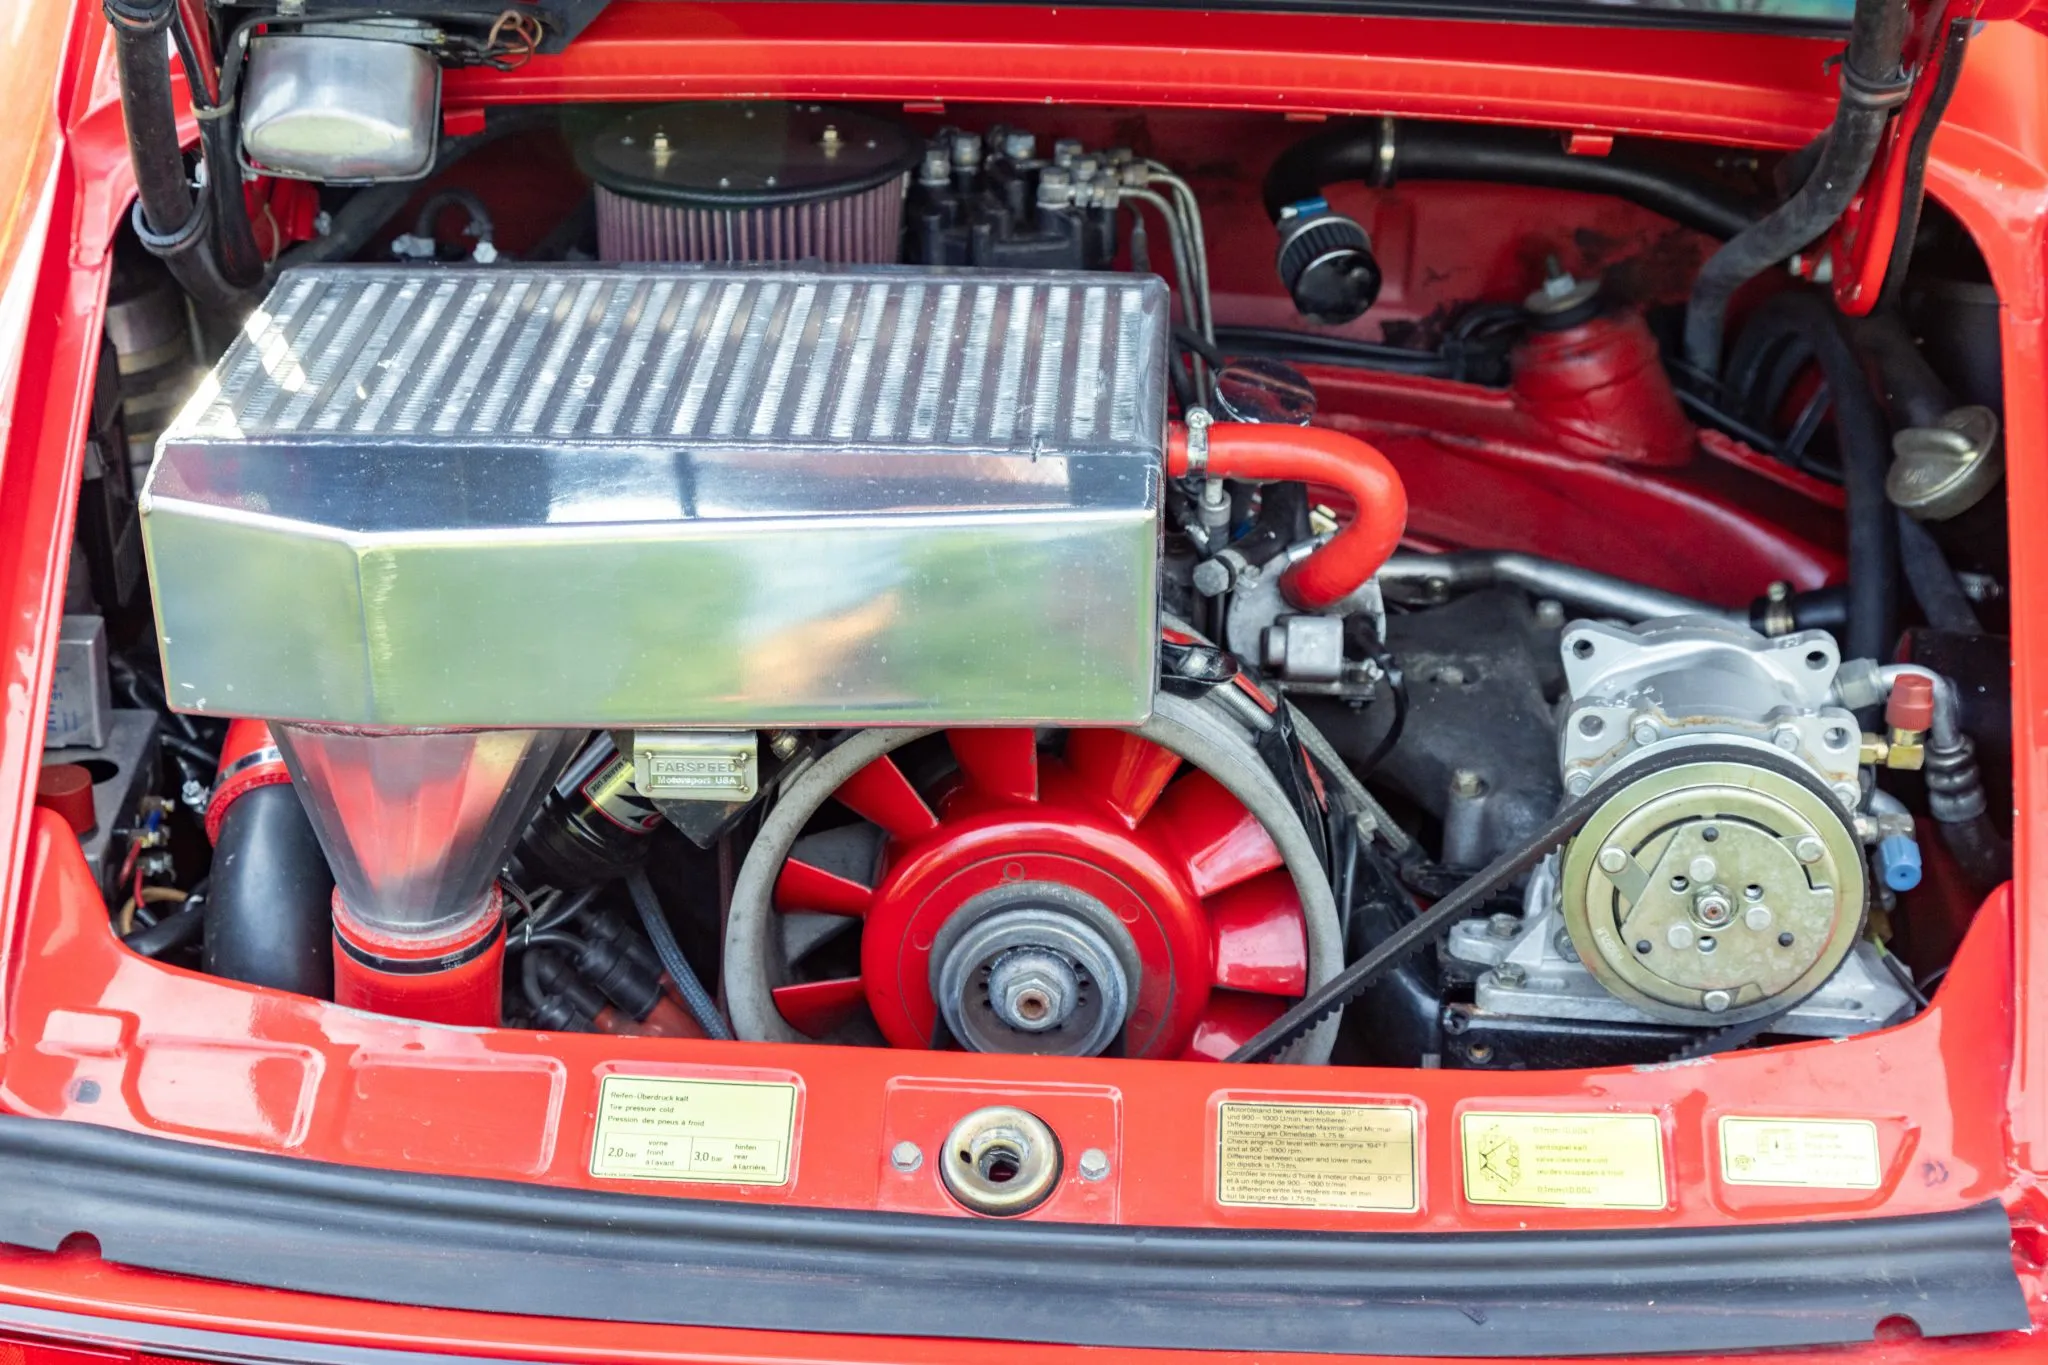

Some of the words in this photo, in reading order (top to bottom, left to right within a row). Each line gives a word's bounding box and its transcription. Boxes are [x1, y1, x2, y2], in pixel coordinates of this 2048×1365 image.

[656, 762, 737, 773] FABSPEED
[657, 776, 711, 786] Motorsport
[715, 776, 737, 785] USA
[607, 1115, 639, 1123] Pression
[657, 1118, 679, 1126] pneus
[687, 1119, 705, 1127] froid
[1226, 1137, 1249, 1145] Check
[734, 1143, 757, 1151] hinten
